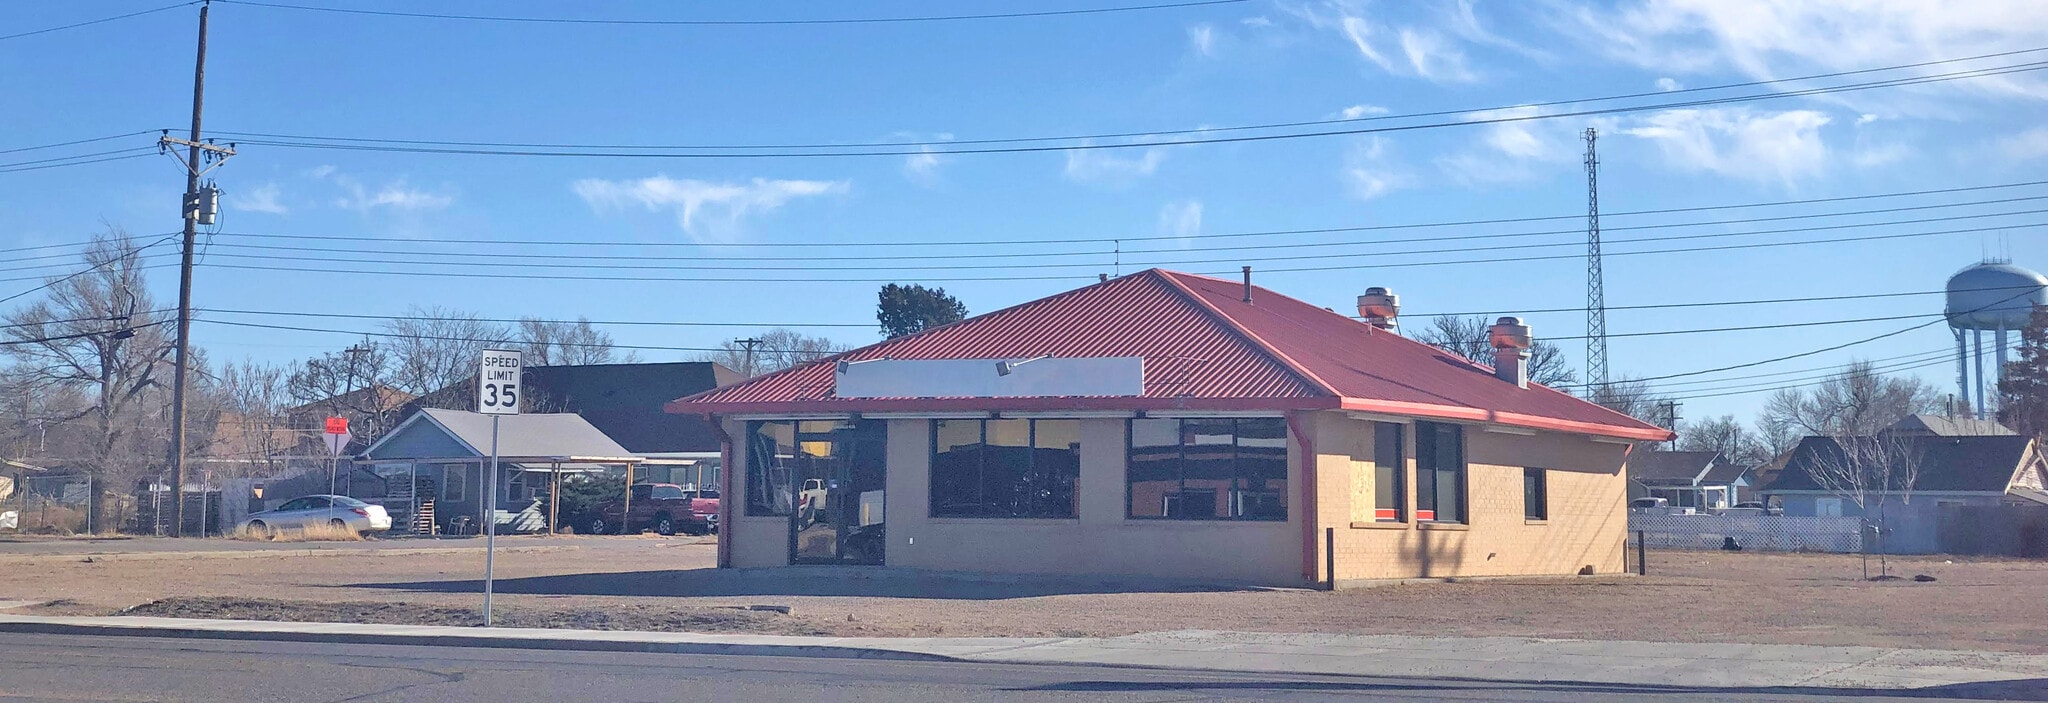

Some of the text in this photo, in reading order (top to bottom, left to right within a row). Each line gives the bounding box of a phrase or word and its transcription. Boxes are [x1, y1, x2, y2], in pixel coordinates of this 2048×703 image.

[485, 357, 518, 367] SPEED
[488, 371, 514, 380] LIMIT
[484, 384, 516, 407] 35
